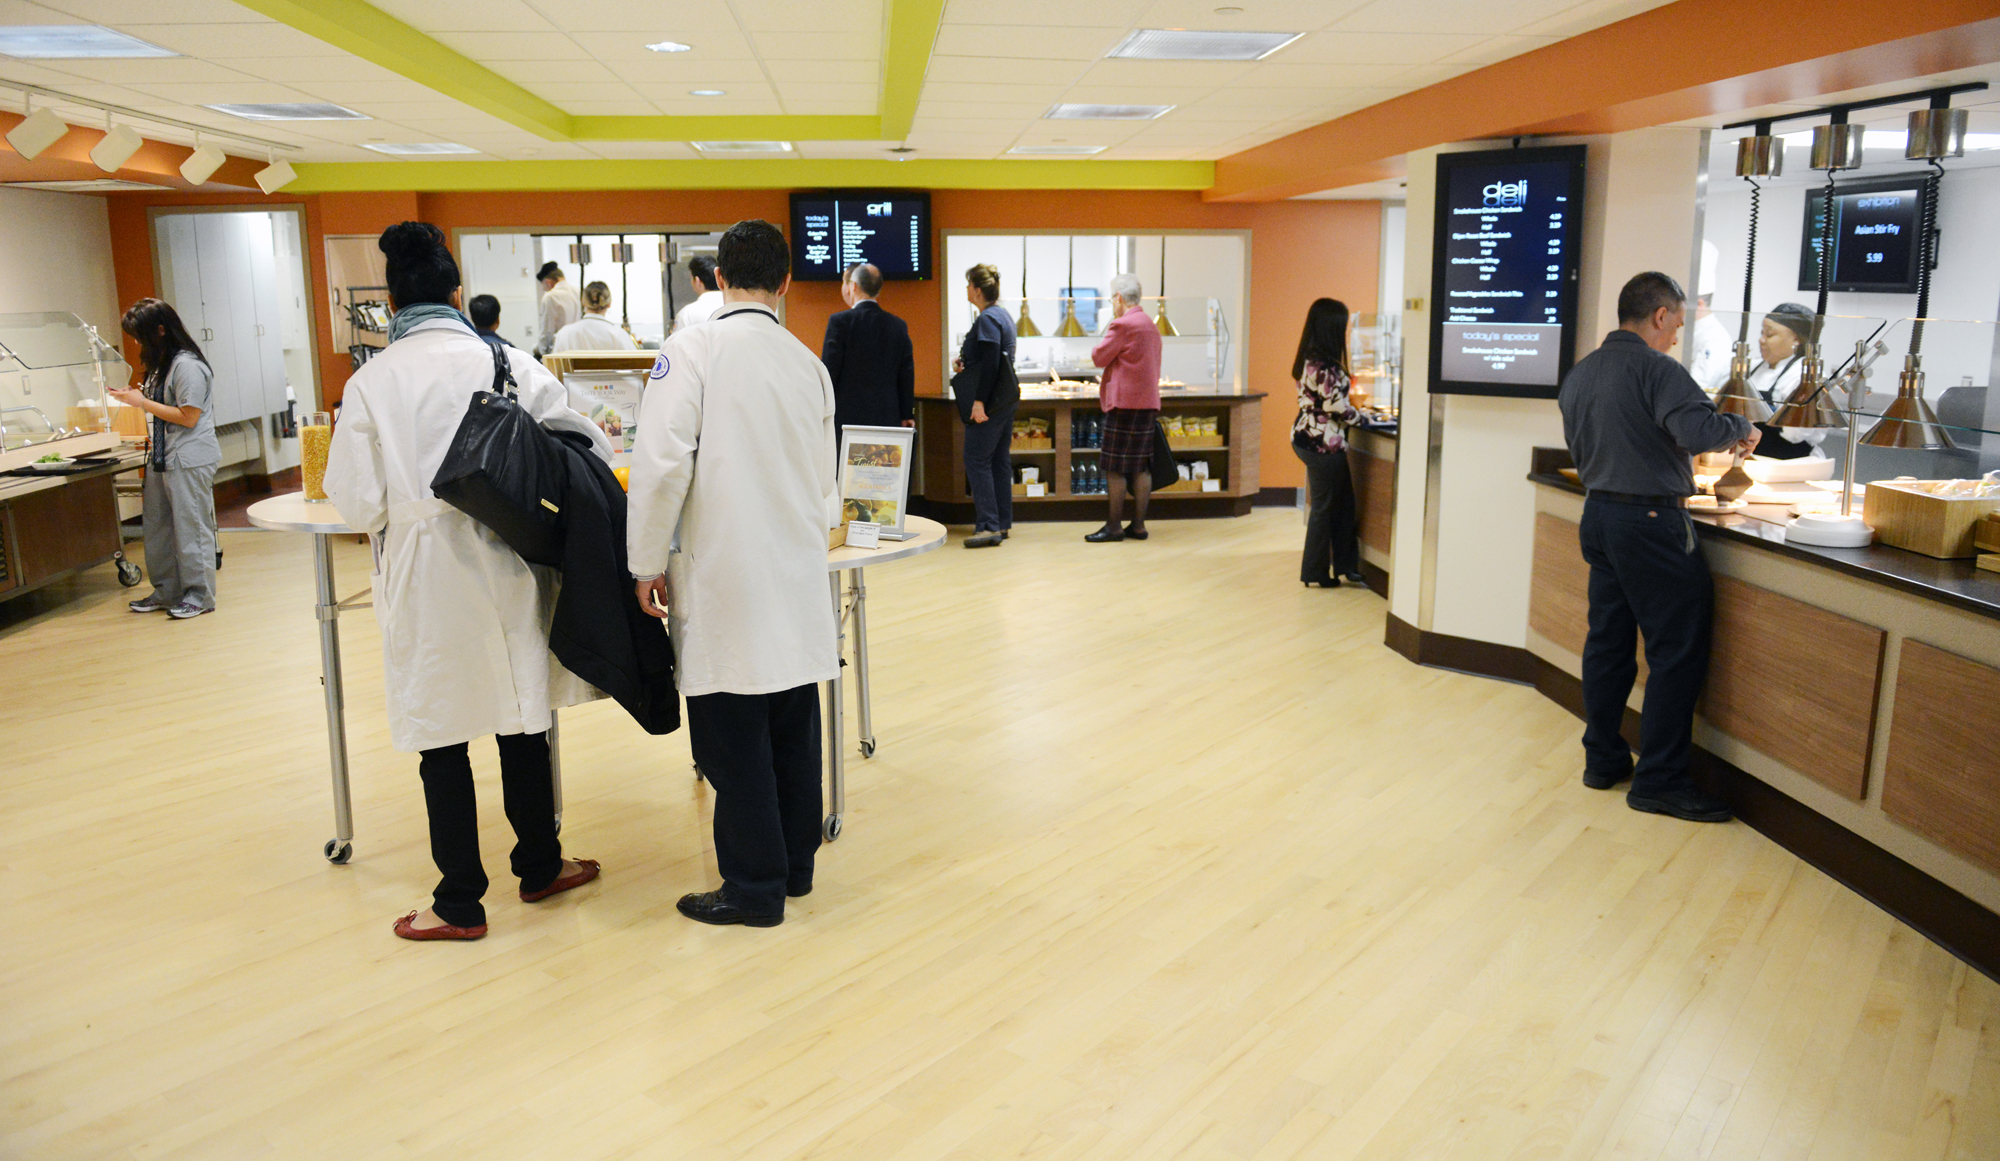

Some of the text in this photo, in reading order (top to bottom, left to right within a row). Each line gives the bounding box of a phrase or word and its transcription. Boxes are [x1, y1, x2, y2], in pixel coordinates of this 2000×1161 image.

[1483, 180, 1527, 198] deli
[1857, 196, 1900, 207] exhibition
[866, 202, 892, 216] grill
[1854, 224, 1900, 236] Asian Stir Fry
[1485, 257, 1500, 265] Wrap
[1866, 253, 1884, 263] 5.99
[1462, 332, 1539, 342] today's special
[1514, 348, 1538, 356] Sandwich
